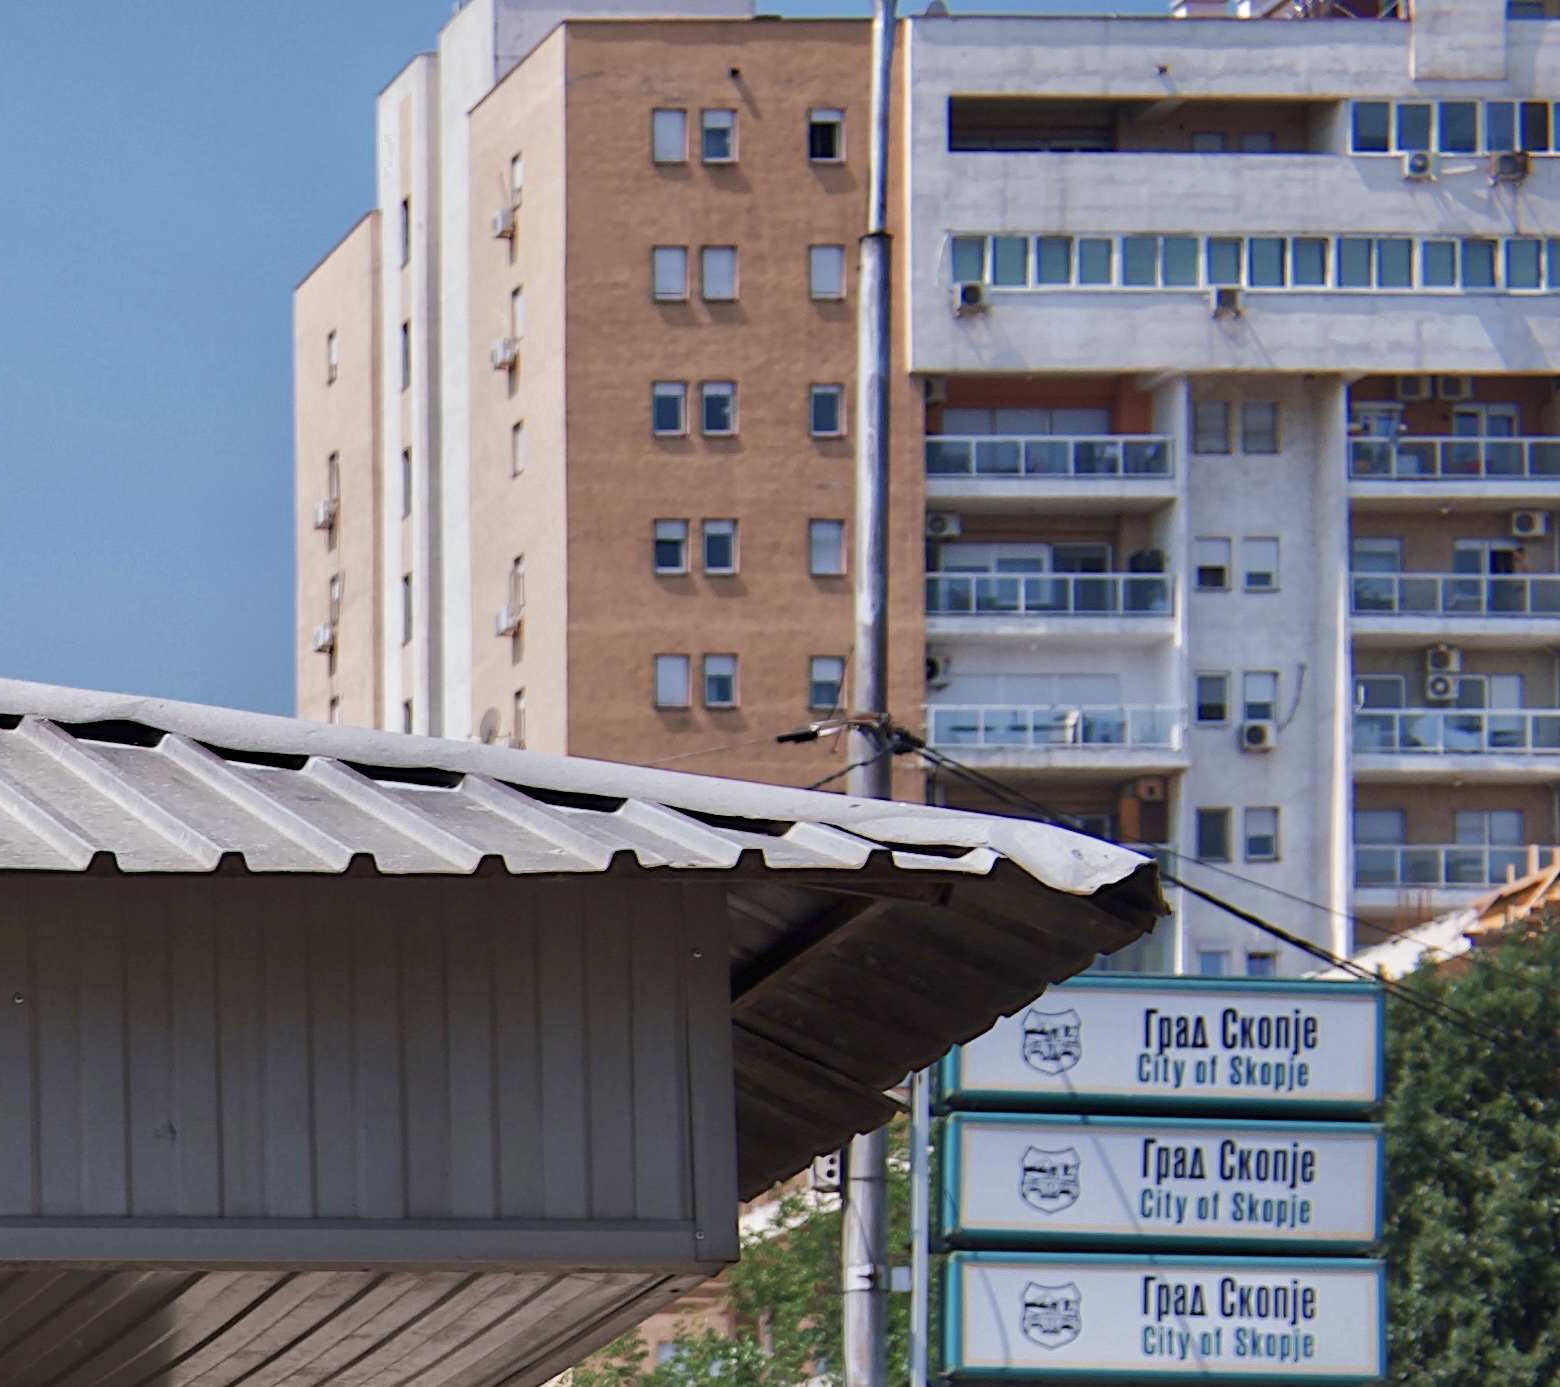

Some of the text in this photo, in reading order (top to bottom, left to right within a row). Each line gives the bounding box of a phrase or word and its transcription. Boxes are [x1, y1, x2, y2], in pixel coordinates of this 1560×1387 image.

[1144, 1007, 1319, 1054] Град Скопје
[1138, 1054, 1310, 1092] City of Skopje
[1141, 1138, 1316, 1187] Град Скопје
[1140, 1189, 1312, 1227] City of Skopje
[1142, 1276, 1318, 1323] Град Скопје
[1142, 1326, 1315, 1363] City of Skopje
